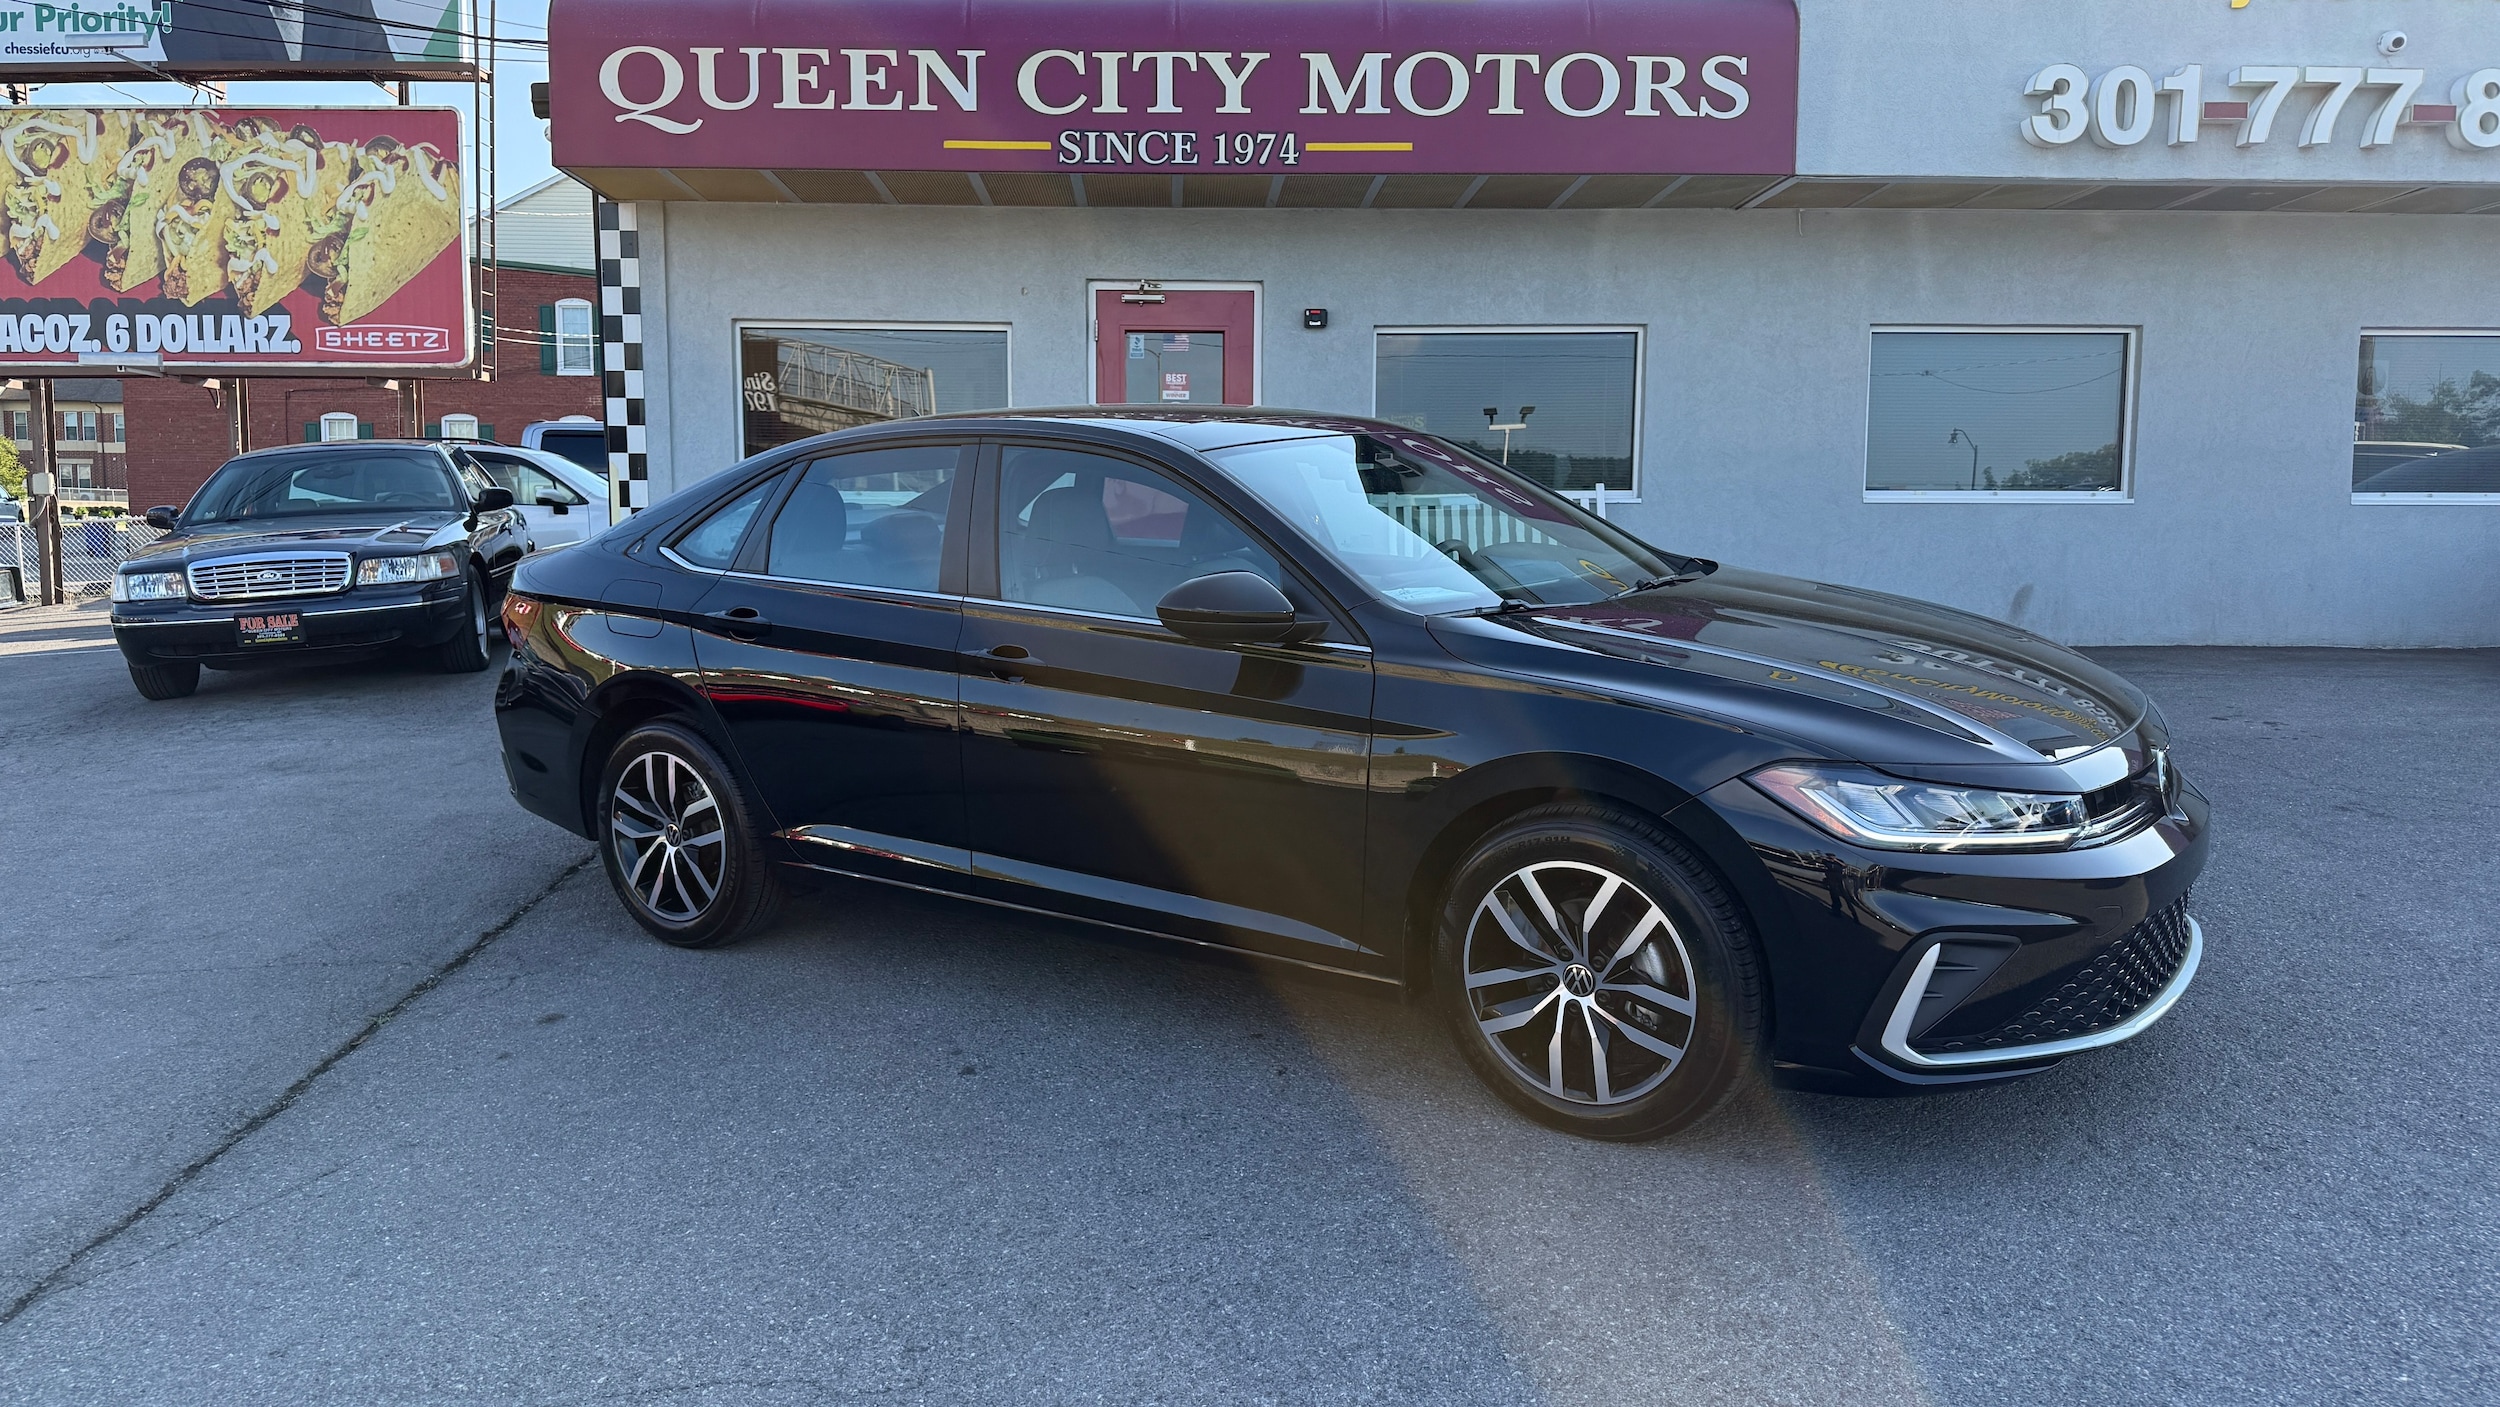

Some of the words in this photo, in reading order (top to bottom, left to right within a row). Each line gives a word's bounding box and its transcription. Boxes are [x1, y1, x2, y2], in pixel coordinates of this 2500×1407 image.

[35, 1, 173, 42] Priority!
[599, 46, 986, 134] QUEEN
[1017, 49, 1270, 115] CITY
[1299, 51, 1749, 120] MOTORS
[1058, 130, 1198, 165] SINCE
[1214, 132, 1299, 165] 1974
[0, 314, 101, 353] ACOZ.
[105, 313, 130, 352] 6
[135, 314, 301, 353] DOLLARZ.
[325, 332, 440, 348] SHEETZ
[1165, 373, 1187, 382] BEST
[239, 616, 266, 630] FOR
[267, 614, 299, 628] SALE
